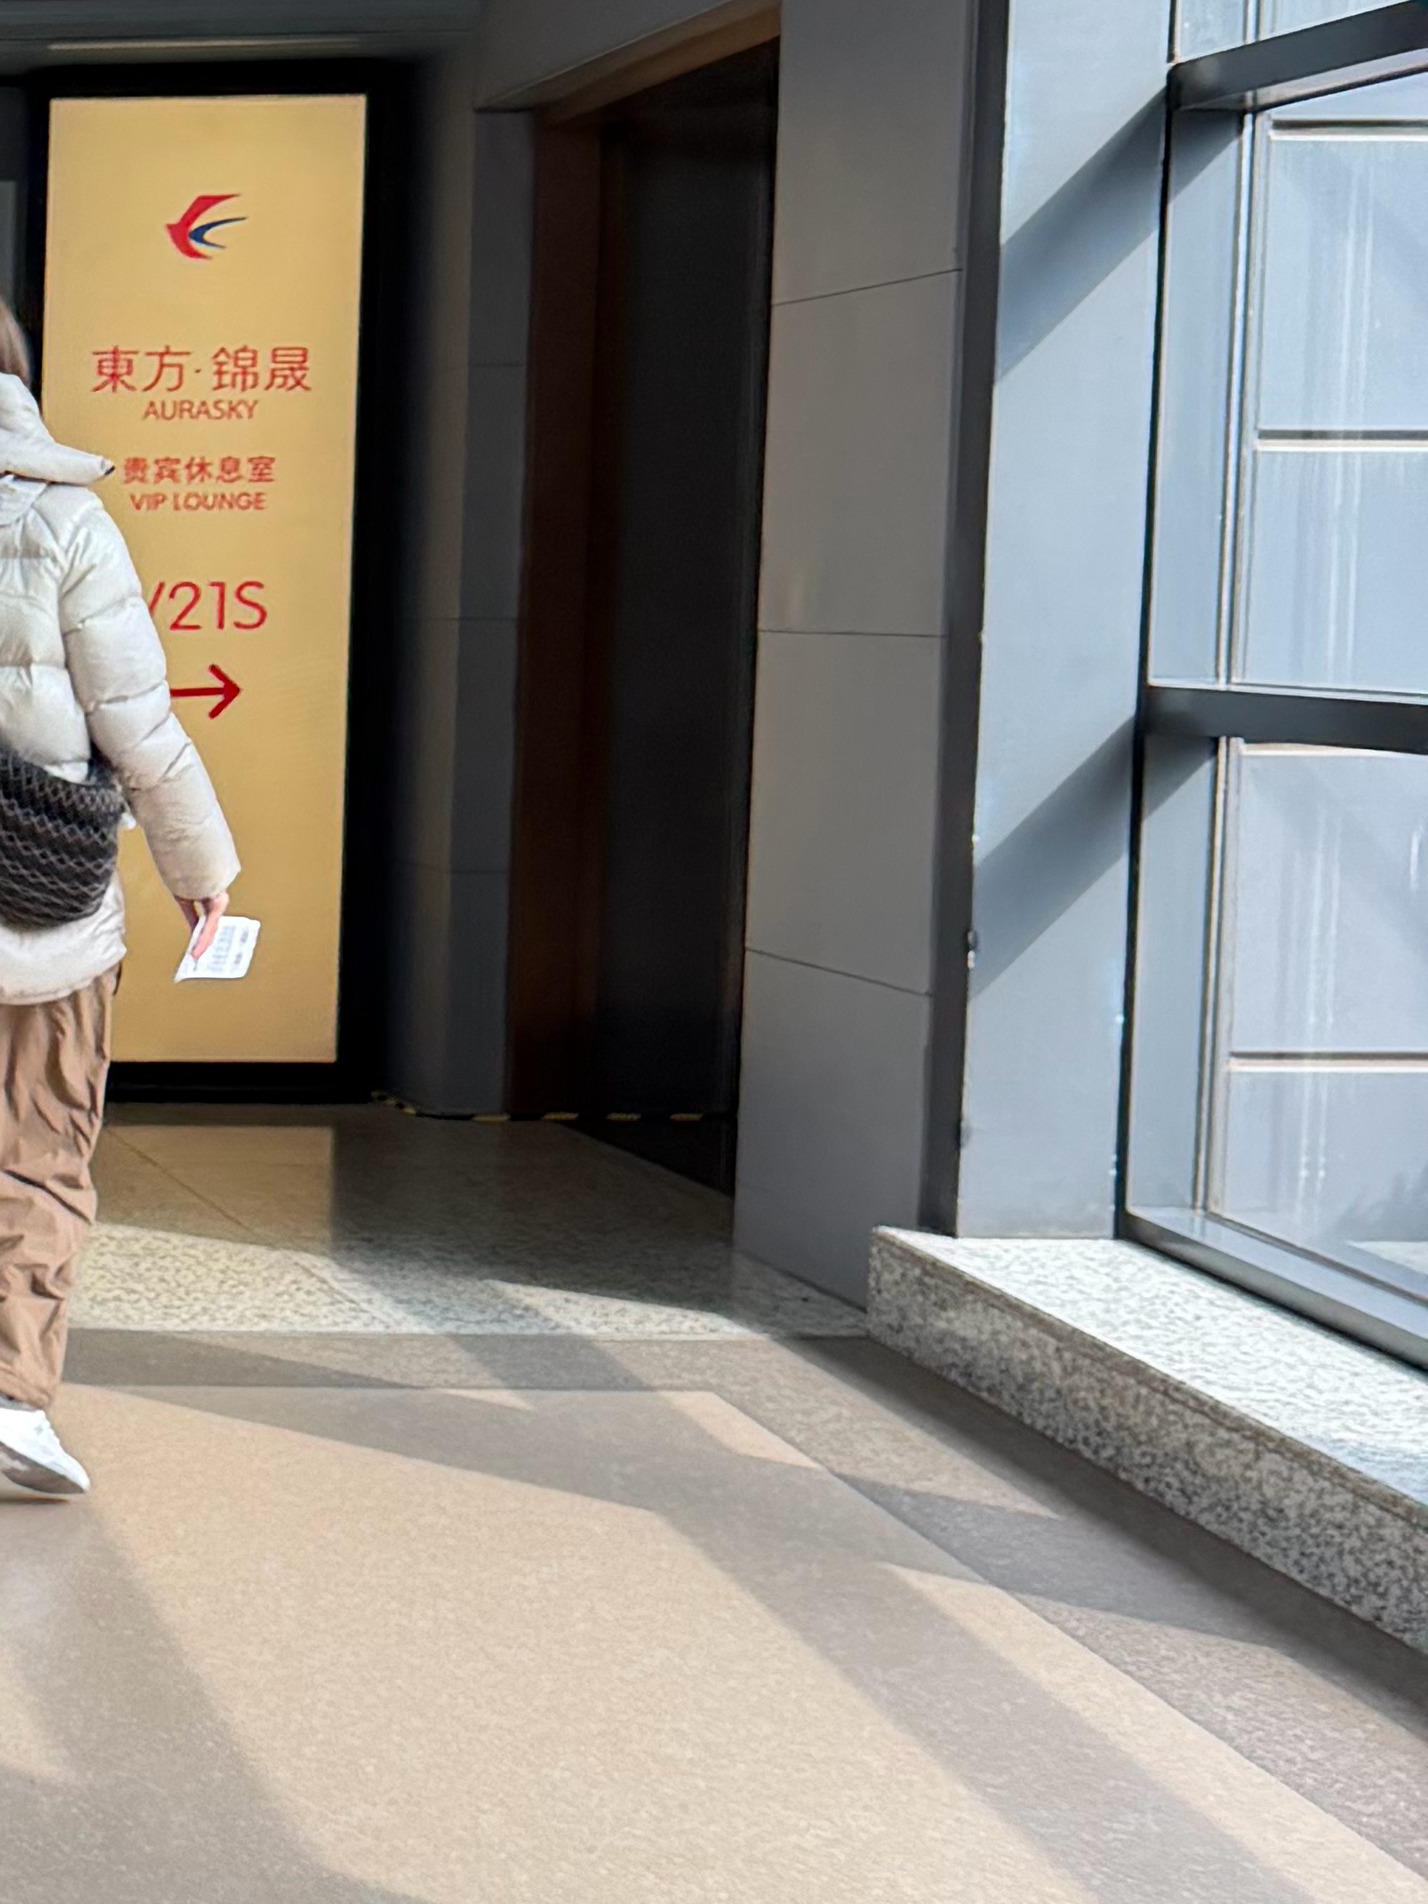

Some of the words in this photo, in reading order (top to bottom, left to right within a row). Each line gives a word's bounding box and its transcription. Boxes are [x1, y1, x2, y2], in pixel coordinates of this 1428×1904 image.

[140, 398, 259, 422] AURASKY
[121, 455, 277, 486] 贵宾休息室
[128, 492, 169, 512] VIP
[172, 491, 268, 512] LOUNGE
